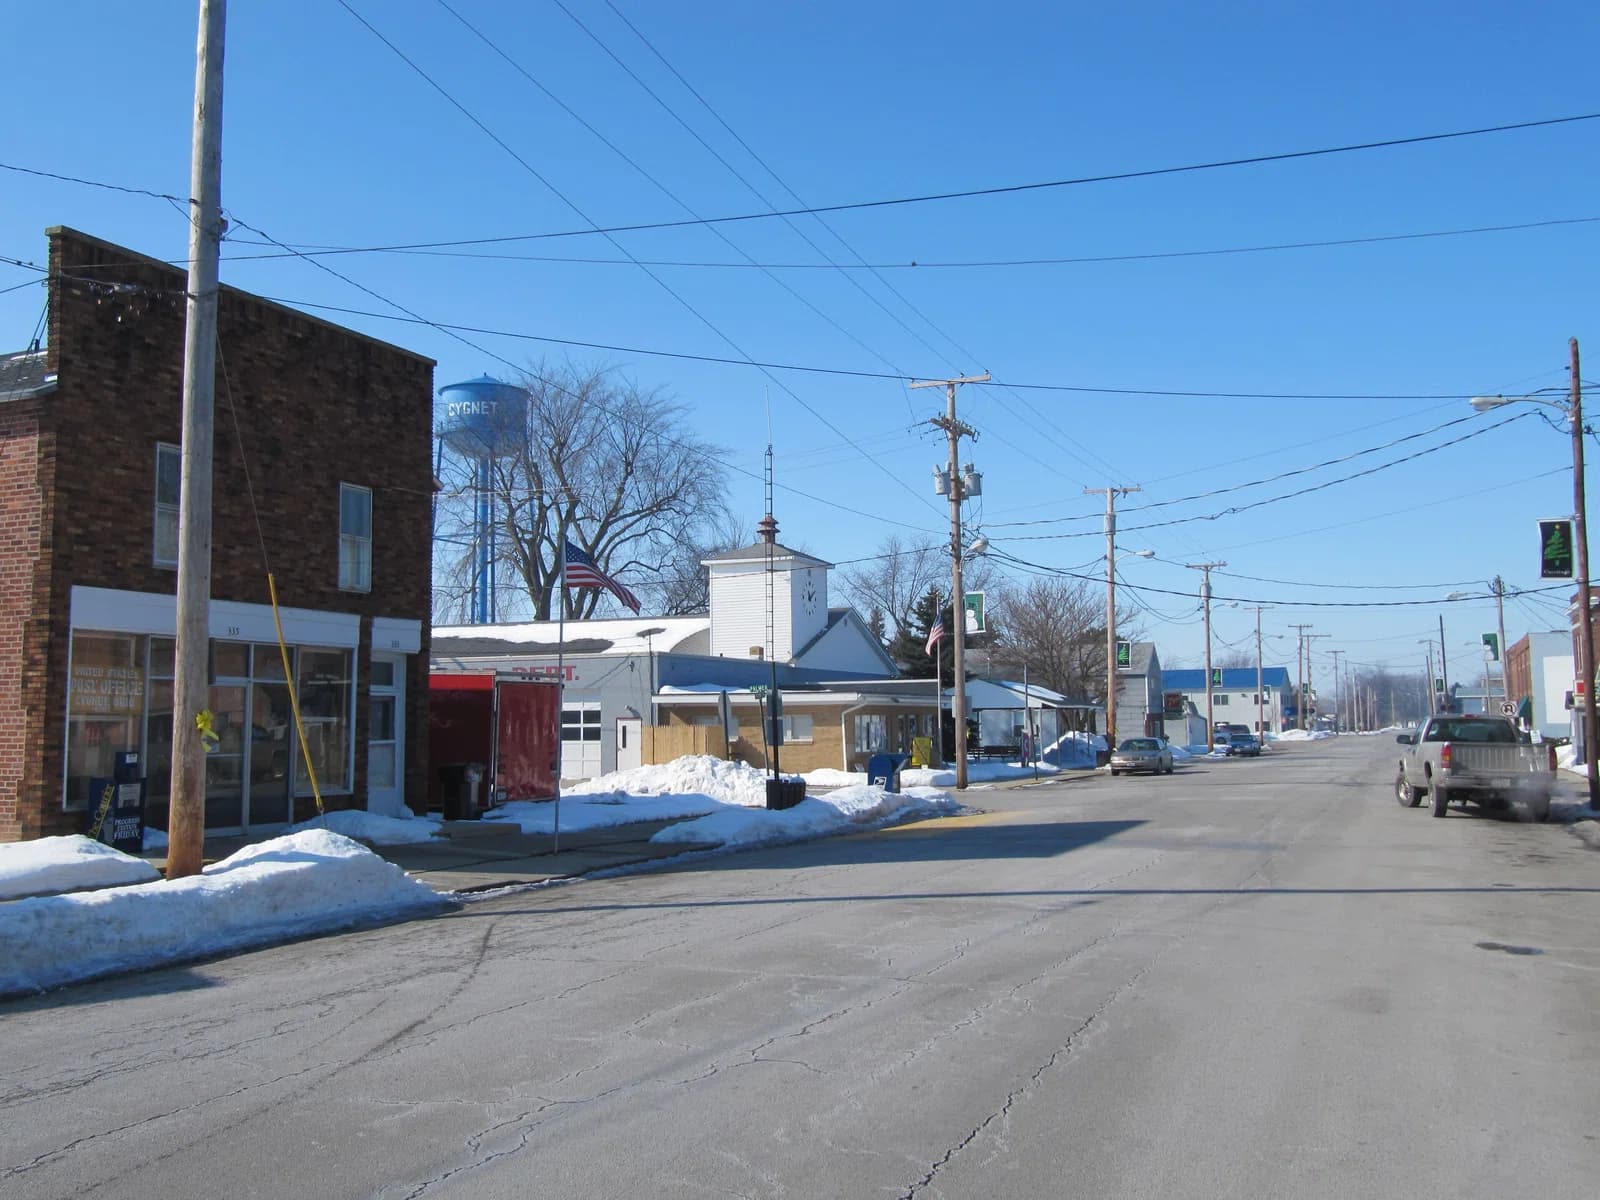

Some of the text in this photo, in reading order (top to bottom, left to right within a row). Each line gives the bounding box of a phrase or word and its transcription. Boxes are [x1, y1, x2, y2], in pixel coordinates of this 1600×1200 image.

[448, 401, 499, 417] CYGNET
[72, 679, 143, 696] POST OFFICE
